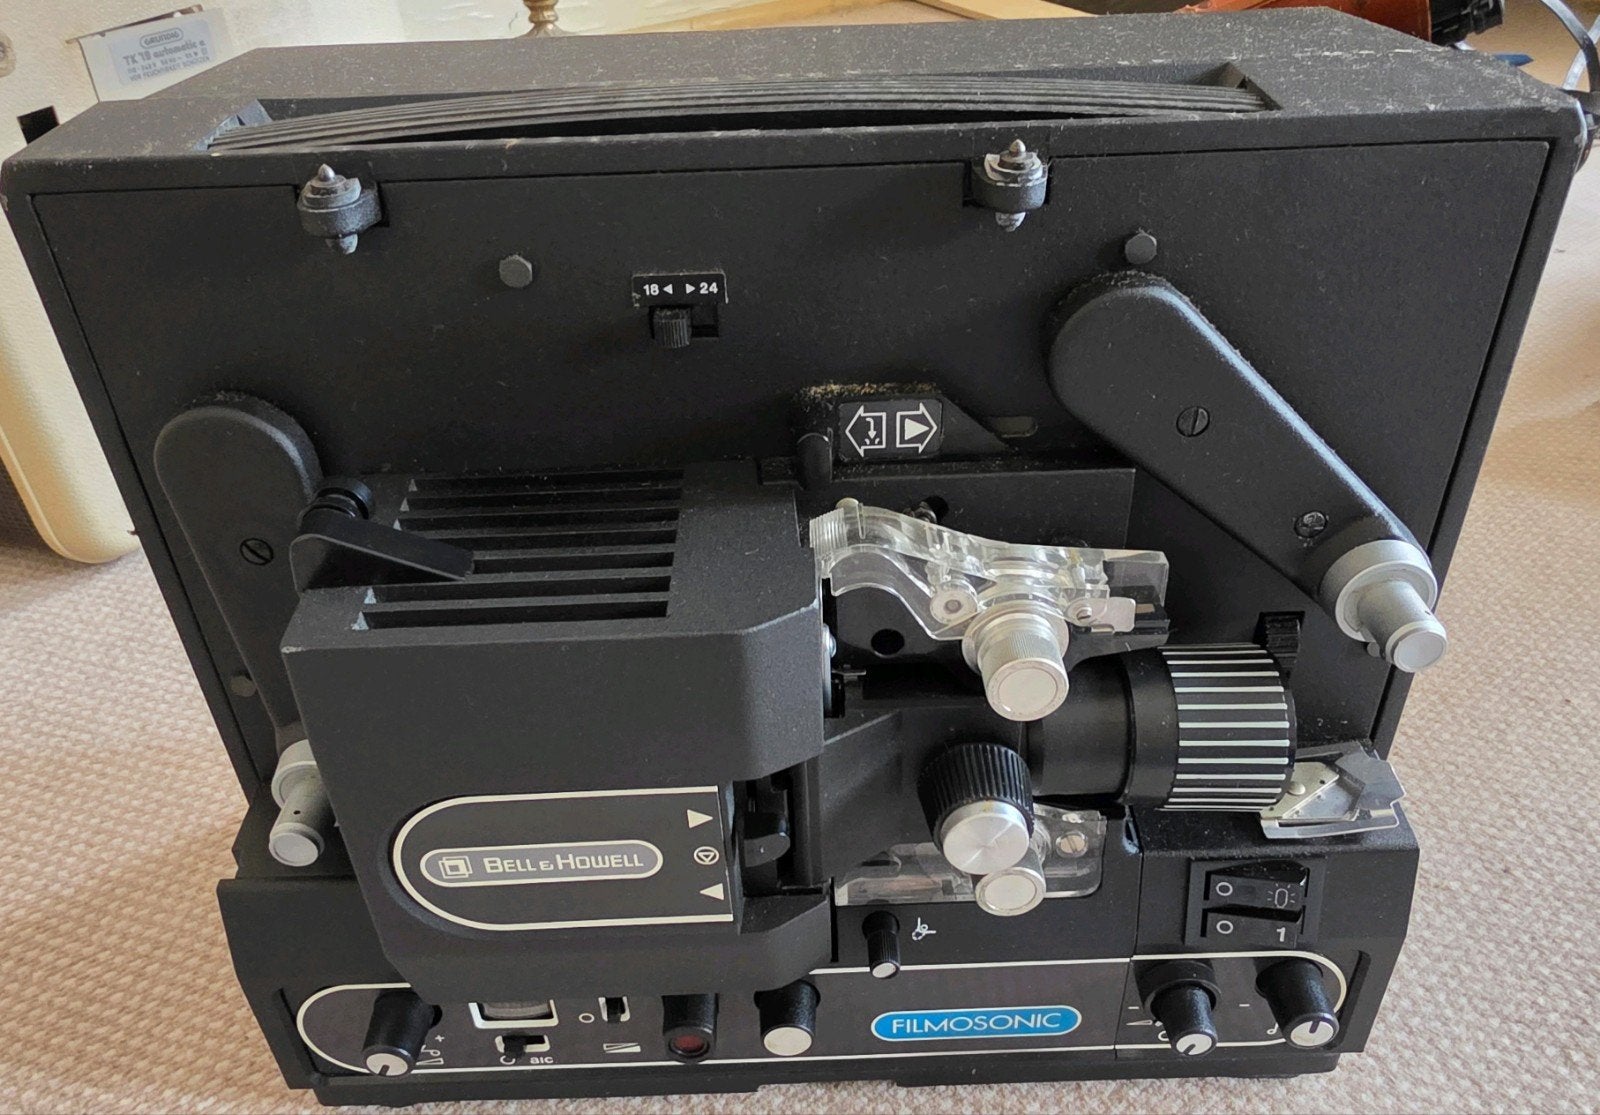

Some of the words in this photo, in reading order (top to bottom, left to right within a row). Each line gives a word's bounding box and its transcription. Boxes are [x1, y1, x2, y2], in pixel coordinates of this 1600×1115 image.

[643, 284, 659, 296] 18
[700, 282, 718, 294] 24
[892, 1013, 1061, 1033] FILMOSONIC
